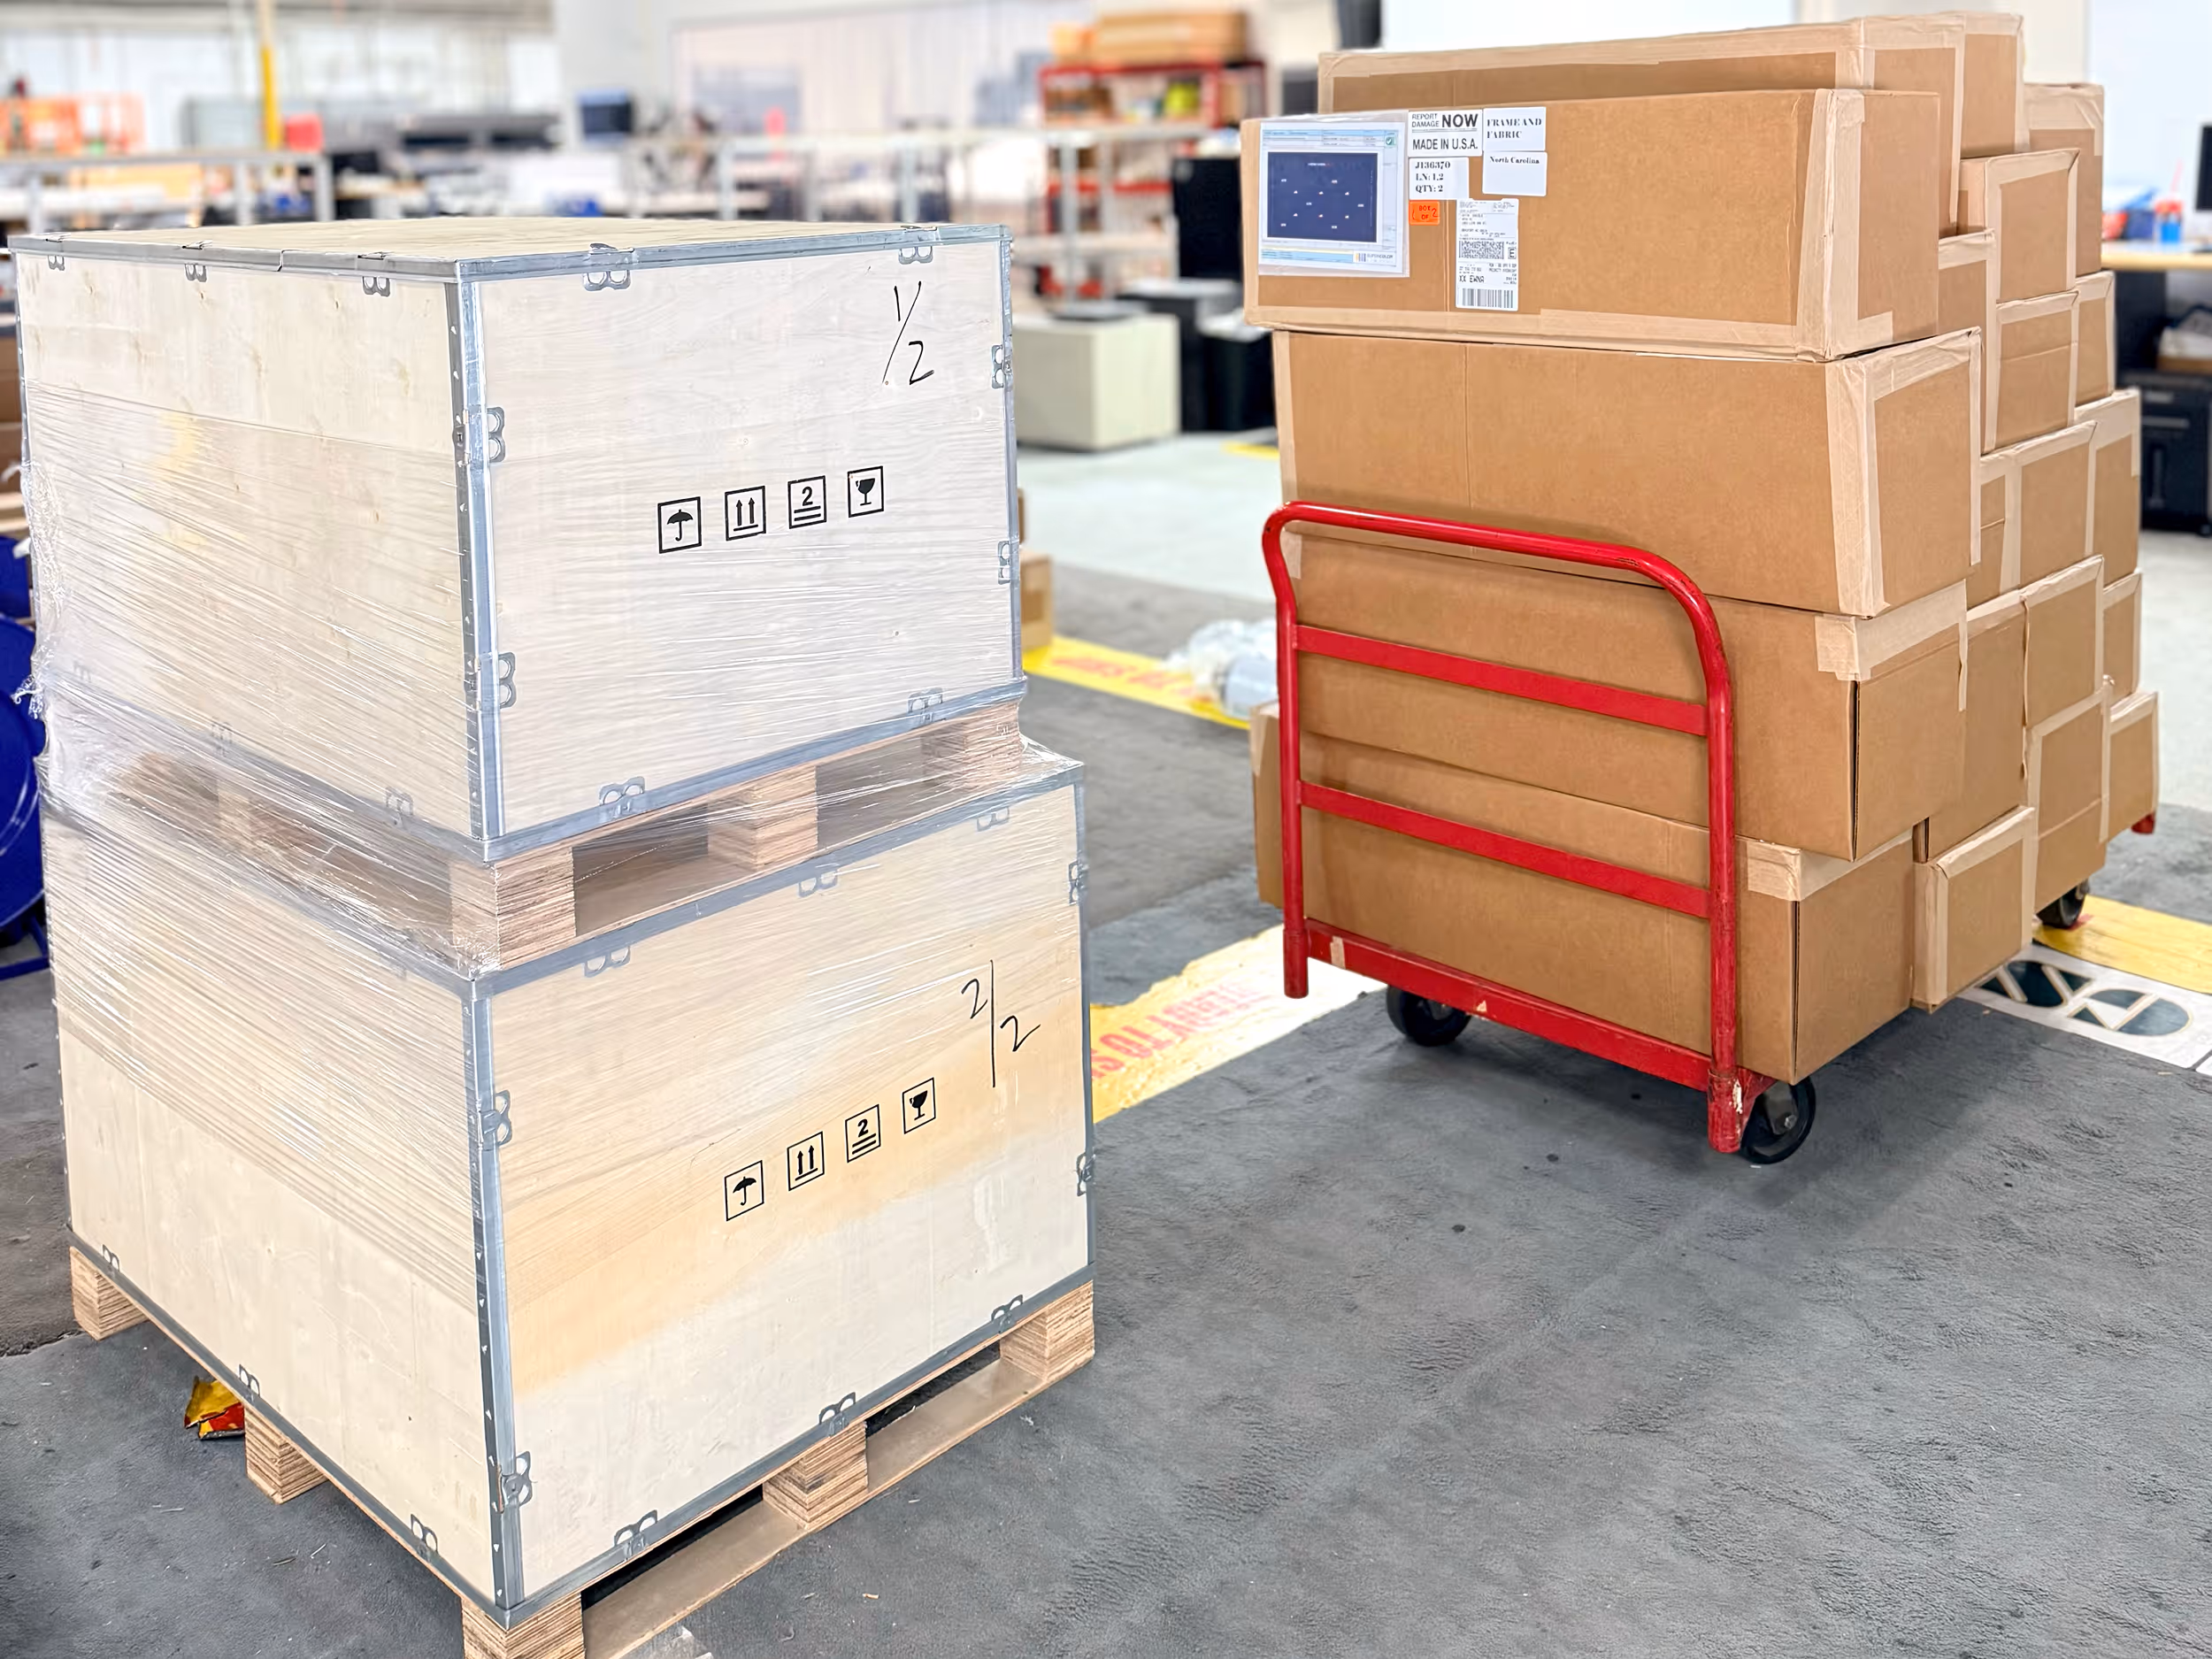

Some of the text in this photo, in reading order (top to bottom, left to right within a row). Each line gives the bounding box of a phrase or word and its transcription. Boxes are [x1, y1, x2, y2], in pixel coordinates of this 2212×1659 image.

[1442, 113, 1479, 127] NOW
[1522, 118, 1542, 127] AND
[1412, 137, 1478, 150] MADE IN U.S.A.
[1415, 184, 1436, 193] QTY:
[802, 486, 813, 506] 2
[857, 1118, 869, 1138] 2
